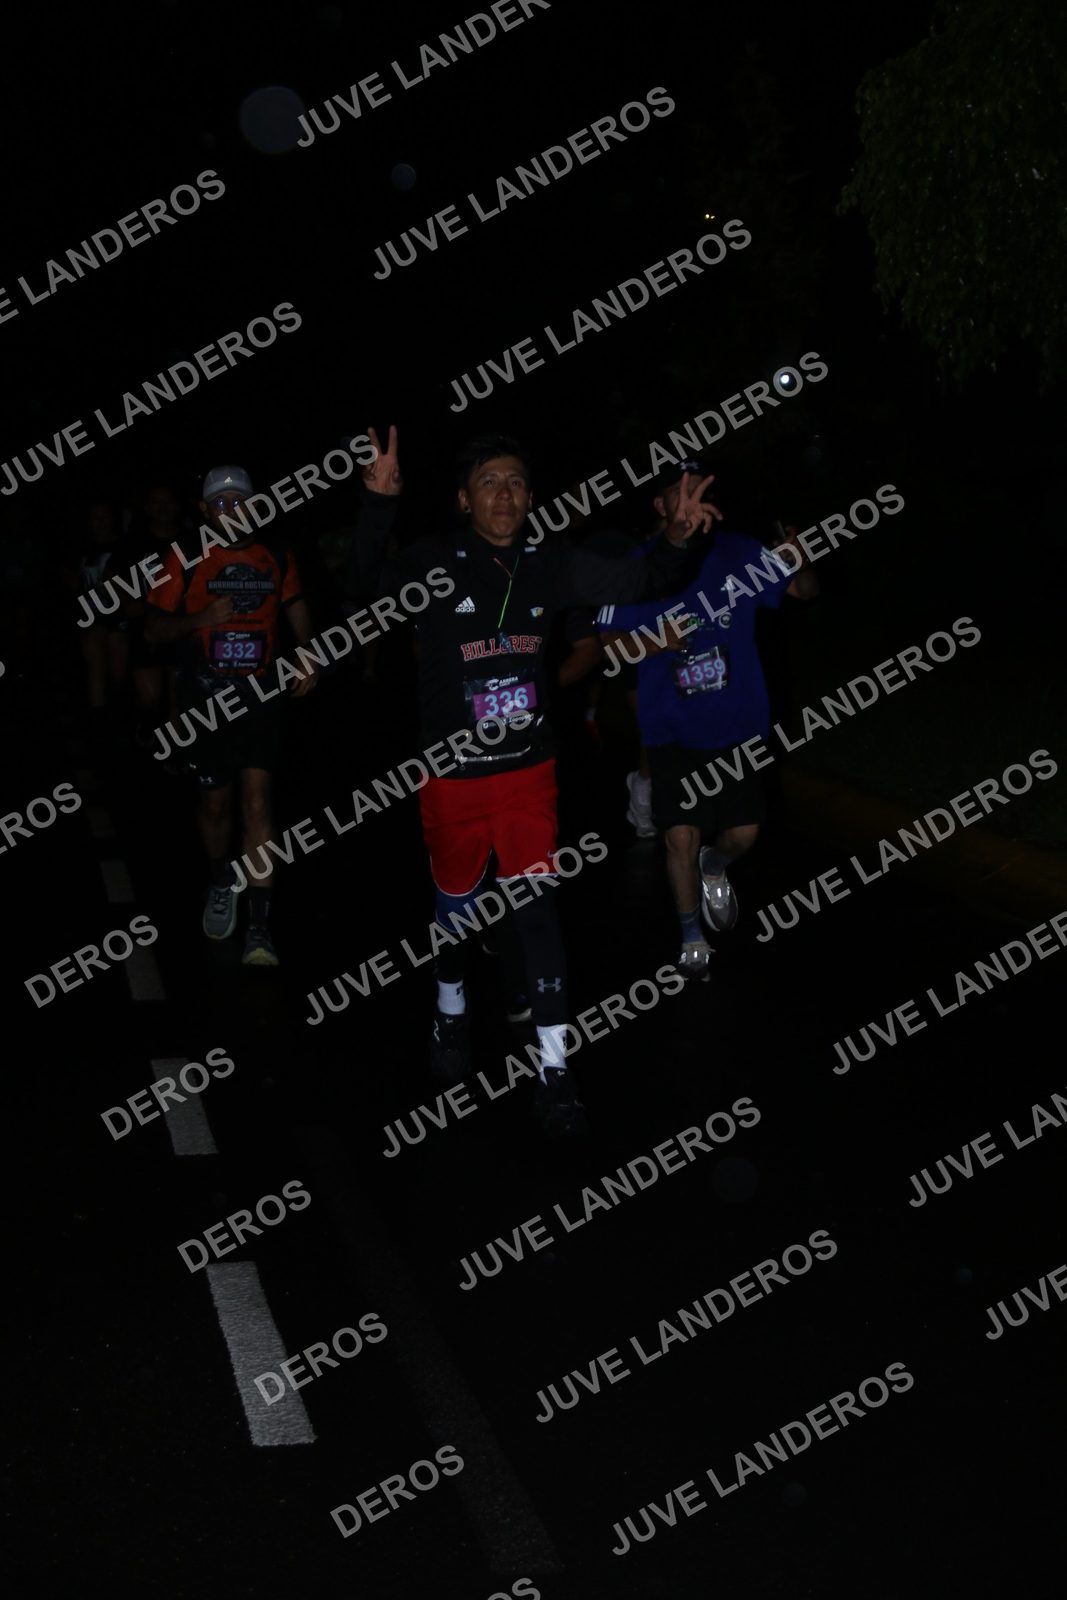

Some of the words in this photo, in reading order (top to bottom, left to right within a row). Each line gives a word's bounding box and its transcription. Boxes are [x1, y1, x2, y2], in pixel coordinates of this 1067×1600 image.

[222, 642, 256, 659] 332
[681, 658, 726, 686] 1359
[484, 687, 529, 716] 336
